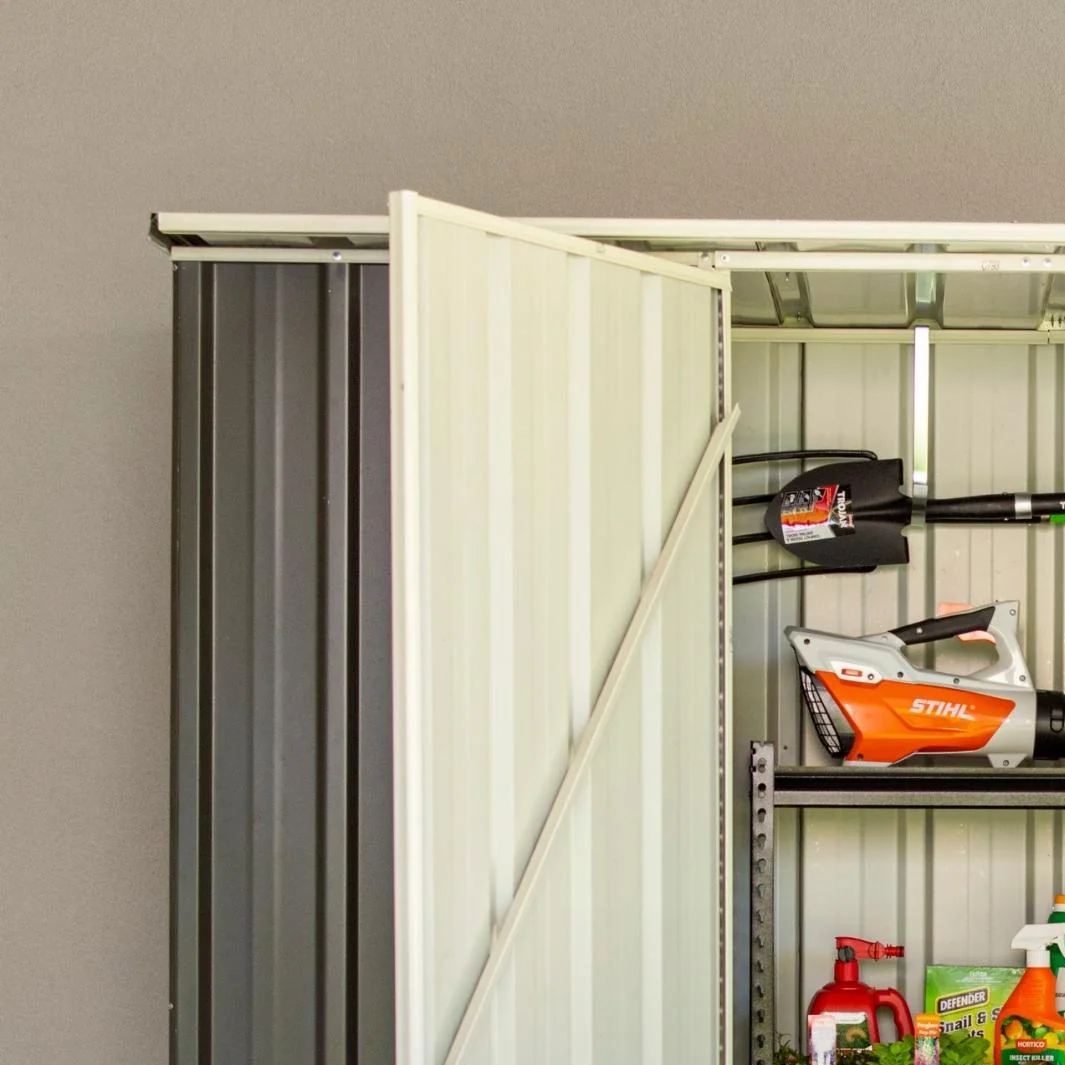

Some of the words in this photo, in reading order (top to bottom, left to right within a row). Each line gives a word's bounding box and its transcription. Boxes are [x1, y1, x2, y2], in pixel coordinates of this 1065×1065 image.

[837, 490, 849, 529] TROJAN
[909, 698, 976, 721] STIHL
[940, 990, 986, 1012] DEFENDER
[977, 1011, 987, 1025] &
